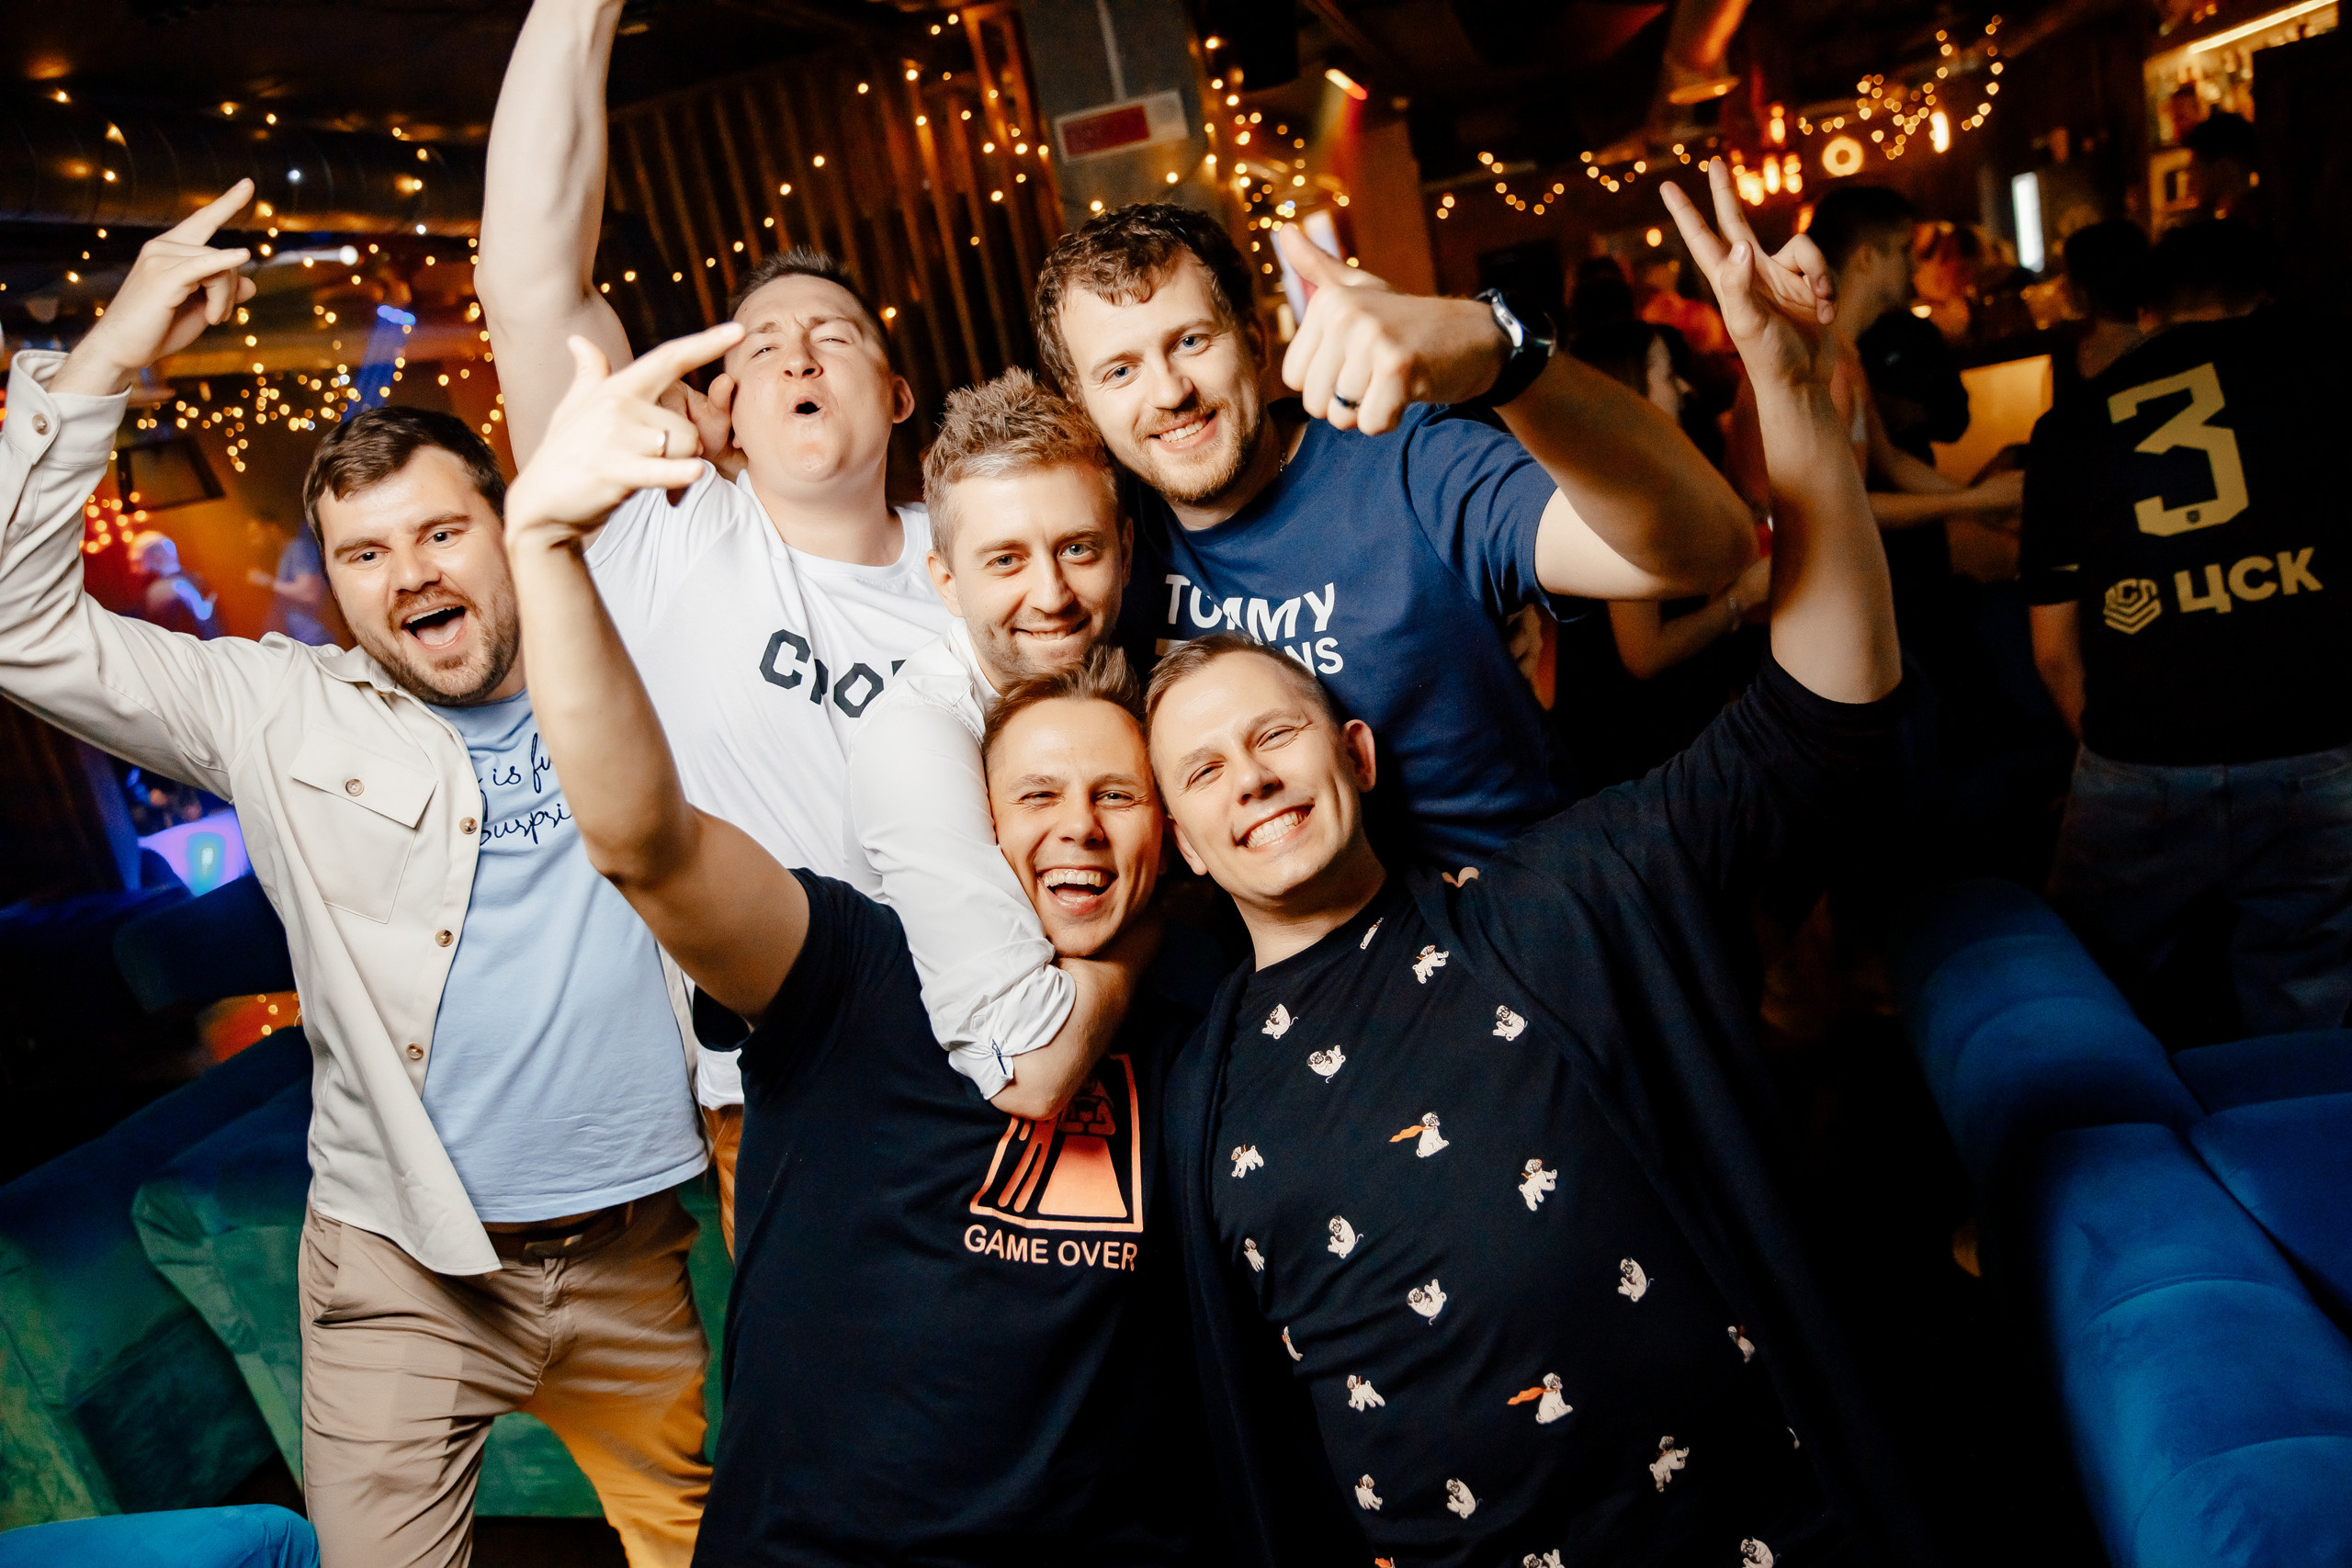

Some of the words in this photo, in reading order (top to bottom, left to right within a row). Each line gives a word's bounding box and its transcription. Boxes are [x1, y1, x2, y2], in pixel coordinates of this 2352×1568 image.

[2108, 362, 2249, 537] 3
[2174, 547, 2324, 614] ЦСК
[492, 765, 522, 786] is
[479, 803, 572, 845] surpri
[965, 1224, 1049, 1264] GAME
[1057, 1240, 1138, 1271] OVER
